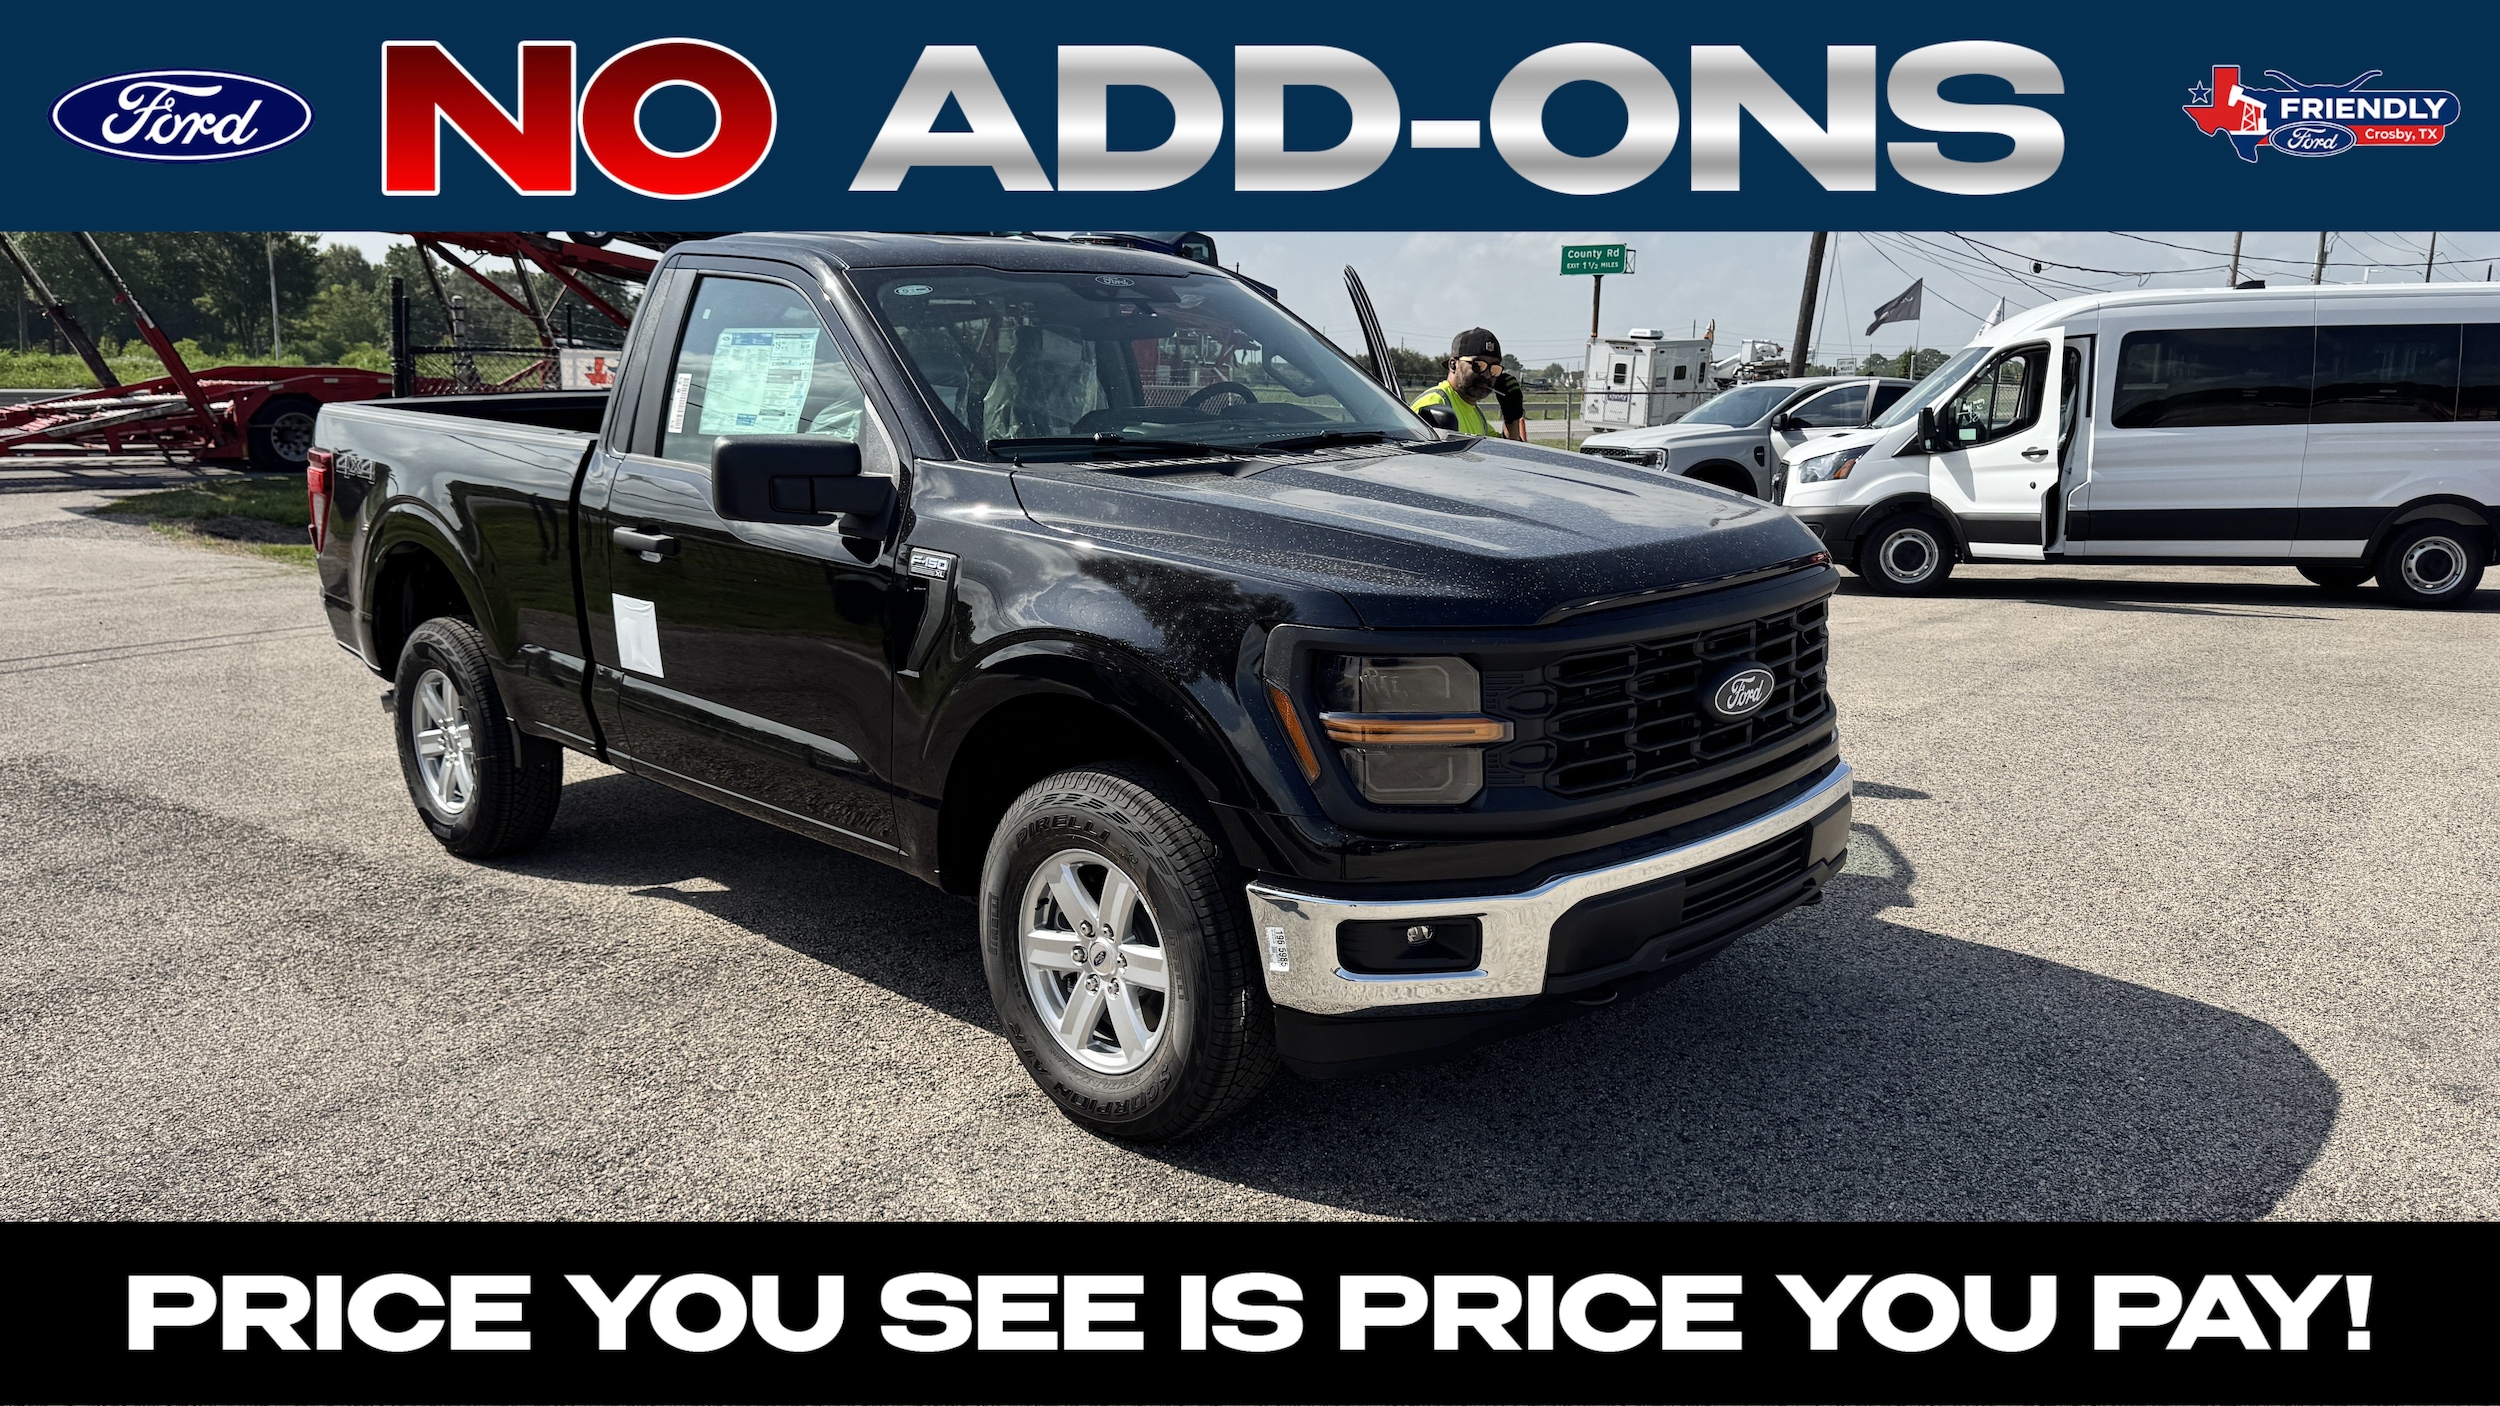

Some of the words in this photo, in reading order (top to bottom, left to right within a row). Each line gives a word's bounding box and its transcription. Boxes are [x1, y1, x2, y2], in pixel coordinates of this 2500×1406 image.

[1567, 249, 1602, 259] County
[1606, 248, 1620, 257] Rd
[910, 554, 949, 571] F-150
[934, 570, 945, 578] XL
[1726, 675, 1765, 709] Ford
[1015, 814, 1111, 848] PIRELLI
[1052, 1063, 1172, 1116] SCORPION
